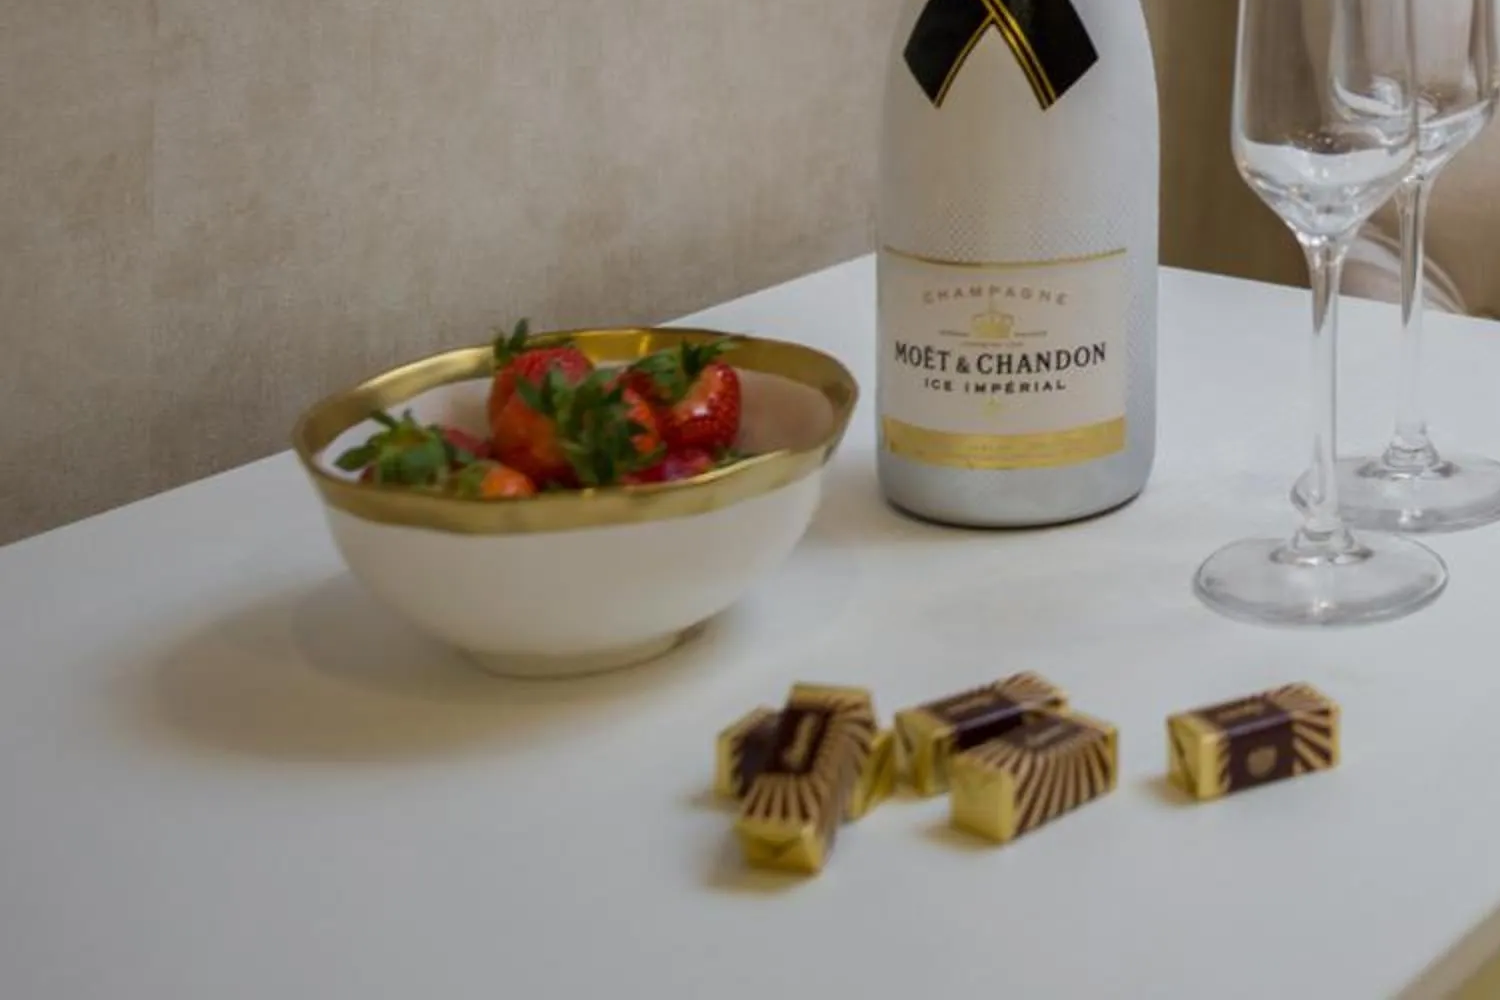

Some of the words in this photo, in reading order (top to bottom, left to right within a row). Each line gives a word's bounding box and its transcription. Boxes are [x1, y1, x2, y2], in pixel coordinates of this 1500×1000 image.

[923, 284, 1068, 305] CHAMPAGNE
[956, 357, 970, 374] &
[976, 342, 1106, 374] CHANDON
[925, 378, 953, 391] ICE
